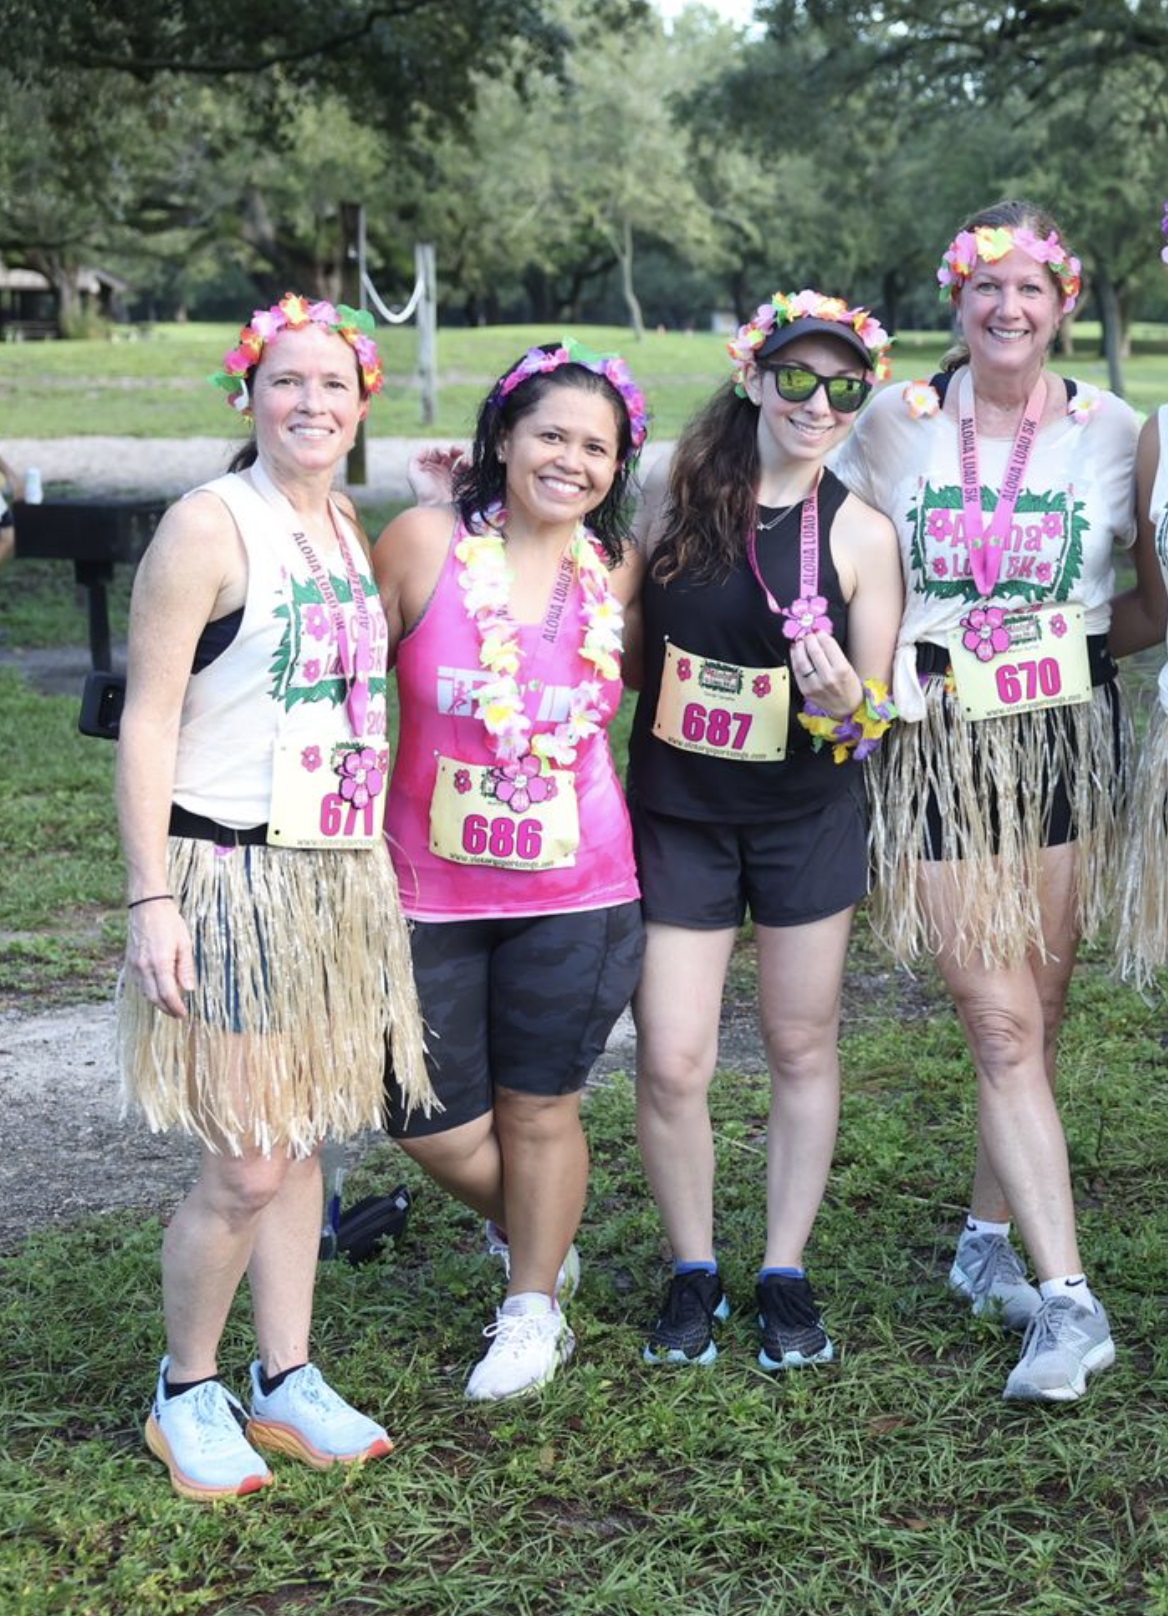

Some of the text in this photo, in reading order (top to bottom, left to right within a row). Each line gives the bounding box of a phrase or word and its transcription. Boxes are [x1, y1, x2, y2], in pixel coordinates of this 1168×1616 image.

[961, 417, 978, 503] ALOHA LUAU 5K
[1001, 419, 1038, 502] ALOHA LUAU 5K
[802, 515, 817, 545] LUAU
[292, 531, 321, 573] ALOHA
[316, 574, 338, 609] LUAU
[802, 551, 817, 587] ALOHA
[1007, 556, 1037, 579] 5K
[542, 556, 576, 644] ALOHA LUAU 5K
[995, 657, 1062, 704] 670
[682, 702, 753, 750] 687
[462, 814, 544, 860] 686
